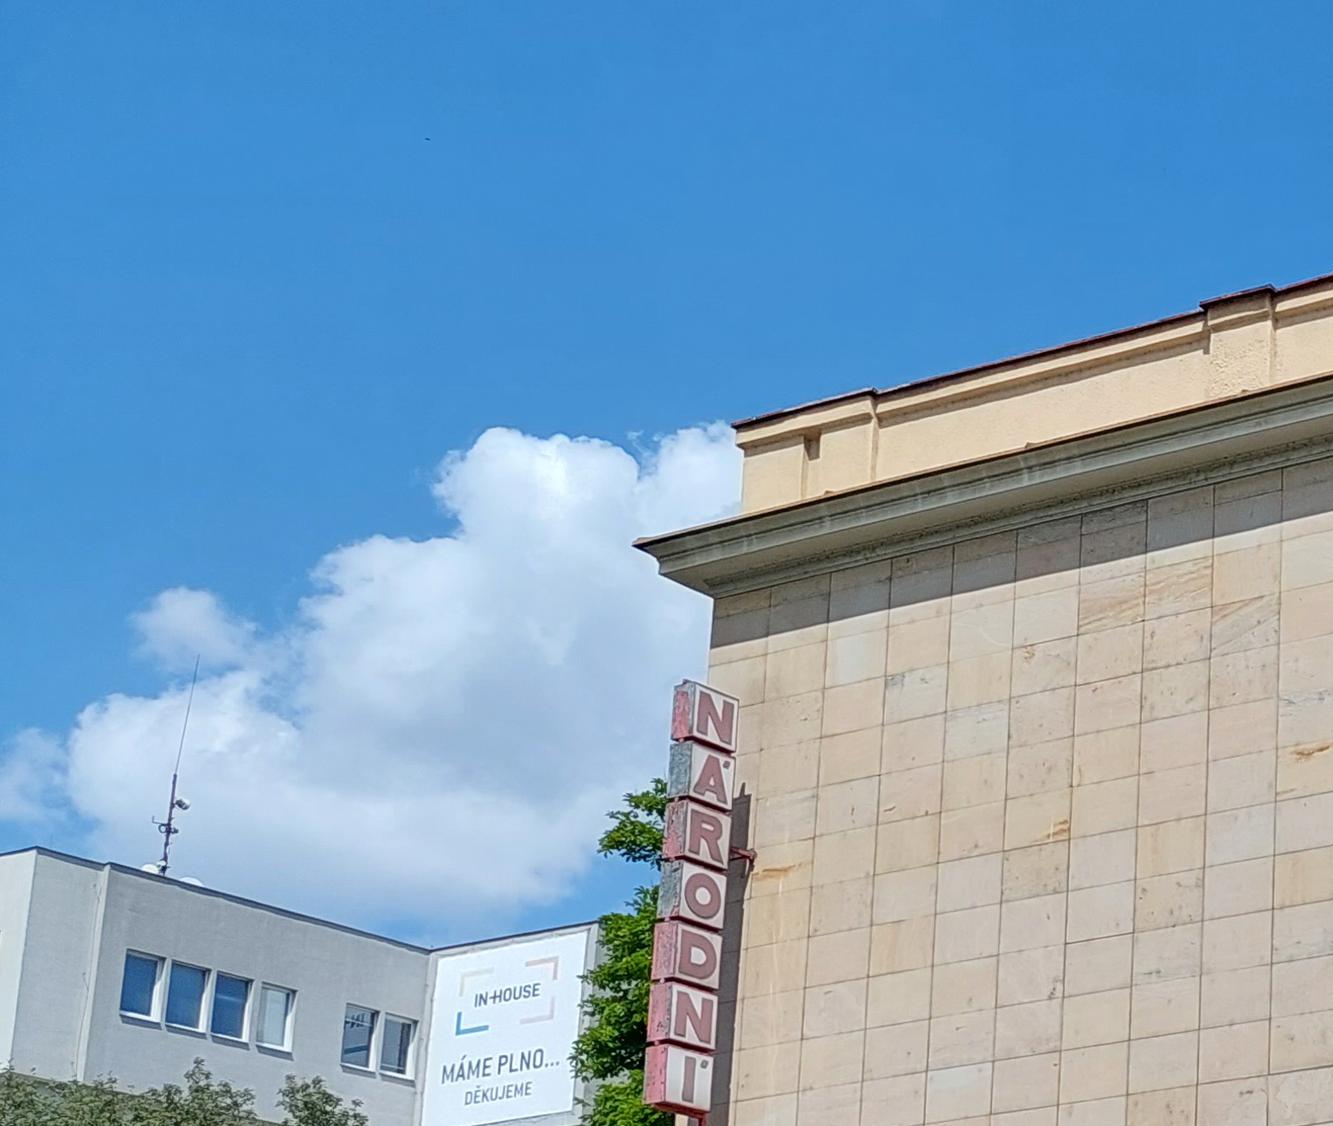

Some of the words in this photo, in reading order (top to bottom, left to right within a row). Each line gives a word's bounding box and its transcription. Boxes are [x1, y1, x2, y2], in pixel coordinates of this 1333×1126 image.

[673, 692, 735, 1105] NÁRODNÍ
[474, 982, 542, 1008] IN-HOUSE
[441, 1054, 494, 1085] MÁME
[497, 1048, 560, 1076] PLNO...
[464, 1081, 533, 1106] DĚKUJEME
